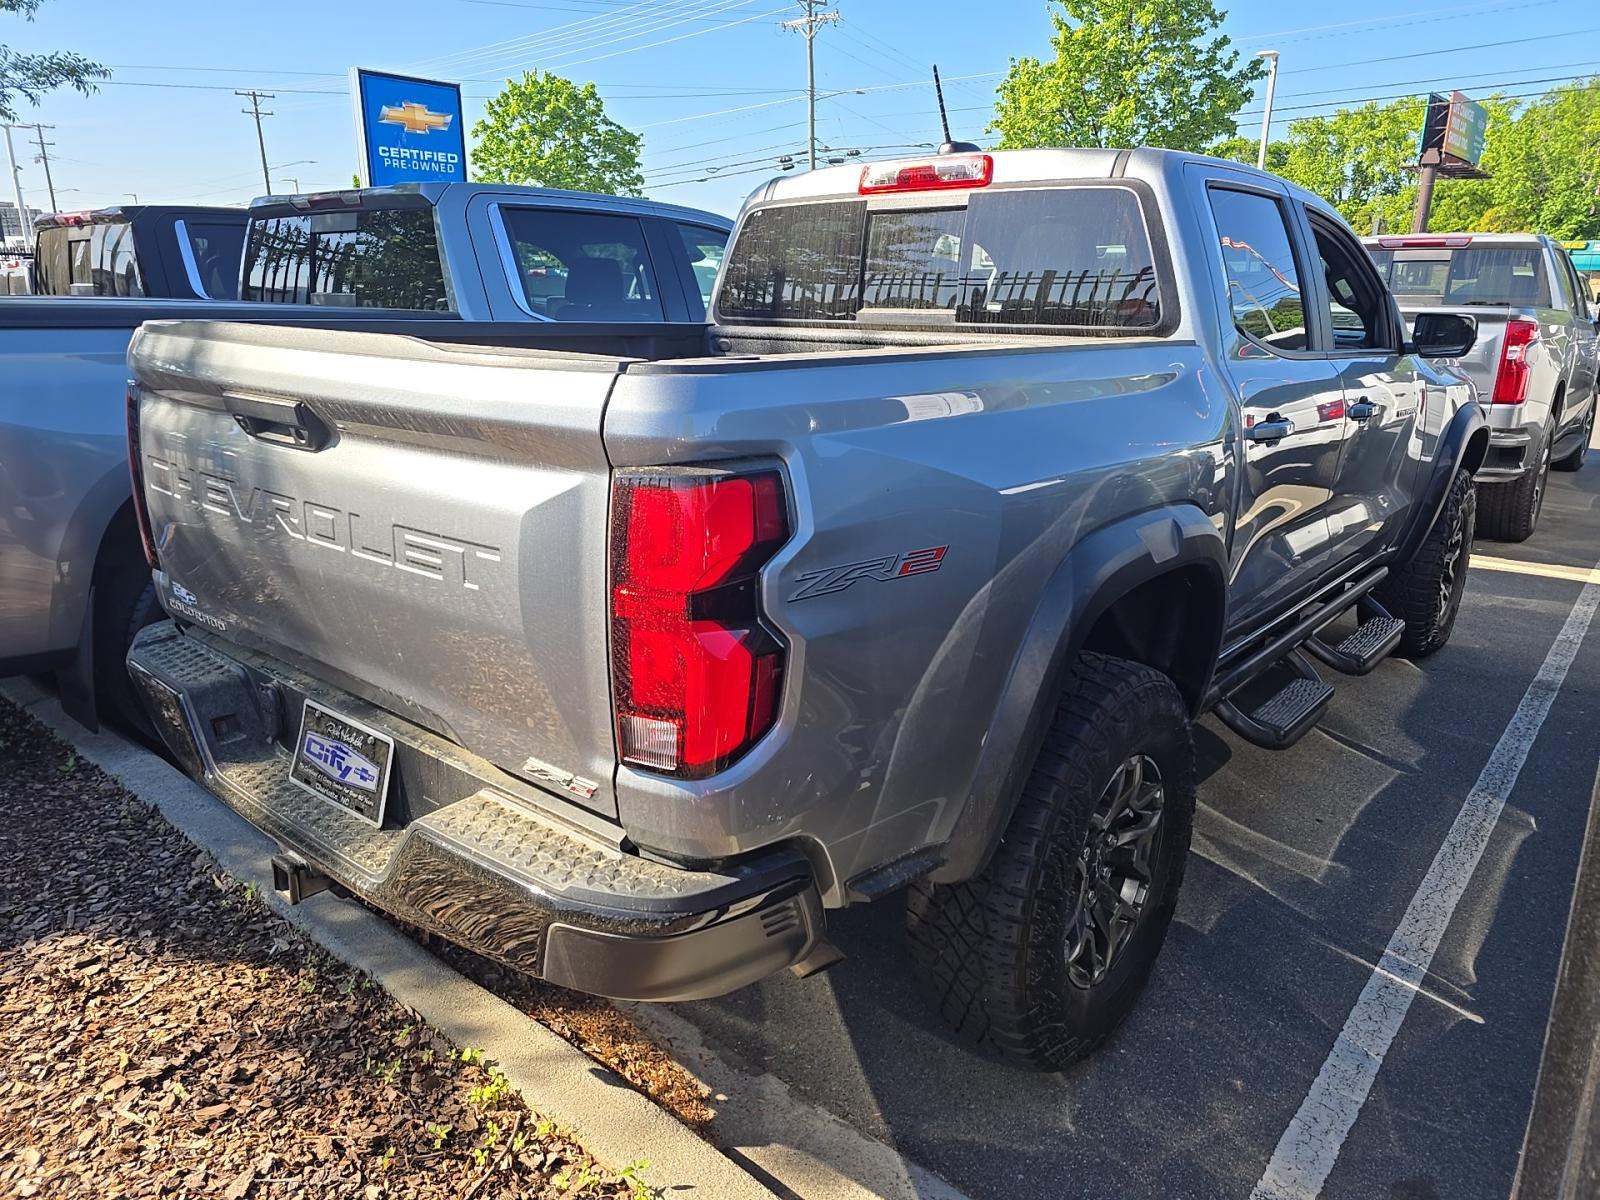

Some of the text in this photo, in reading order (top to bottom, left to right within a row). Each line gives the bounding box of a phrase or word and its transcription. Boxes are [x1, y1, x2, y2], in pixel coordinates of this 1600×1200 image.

[378, 146, 458, 164] CERTIFIED
[384, 158, 455, 173] PRE-OWNED
[147, 454, 501, 591] CHEVROLET
[786, 544, 950, 603] ZR2
